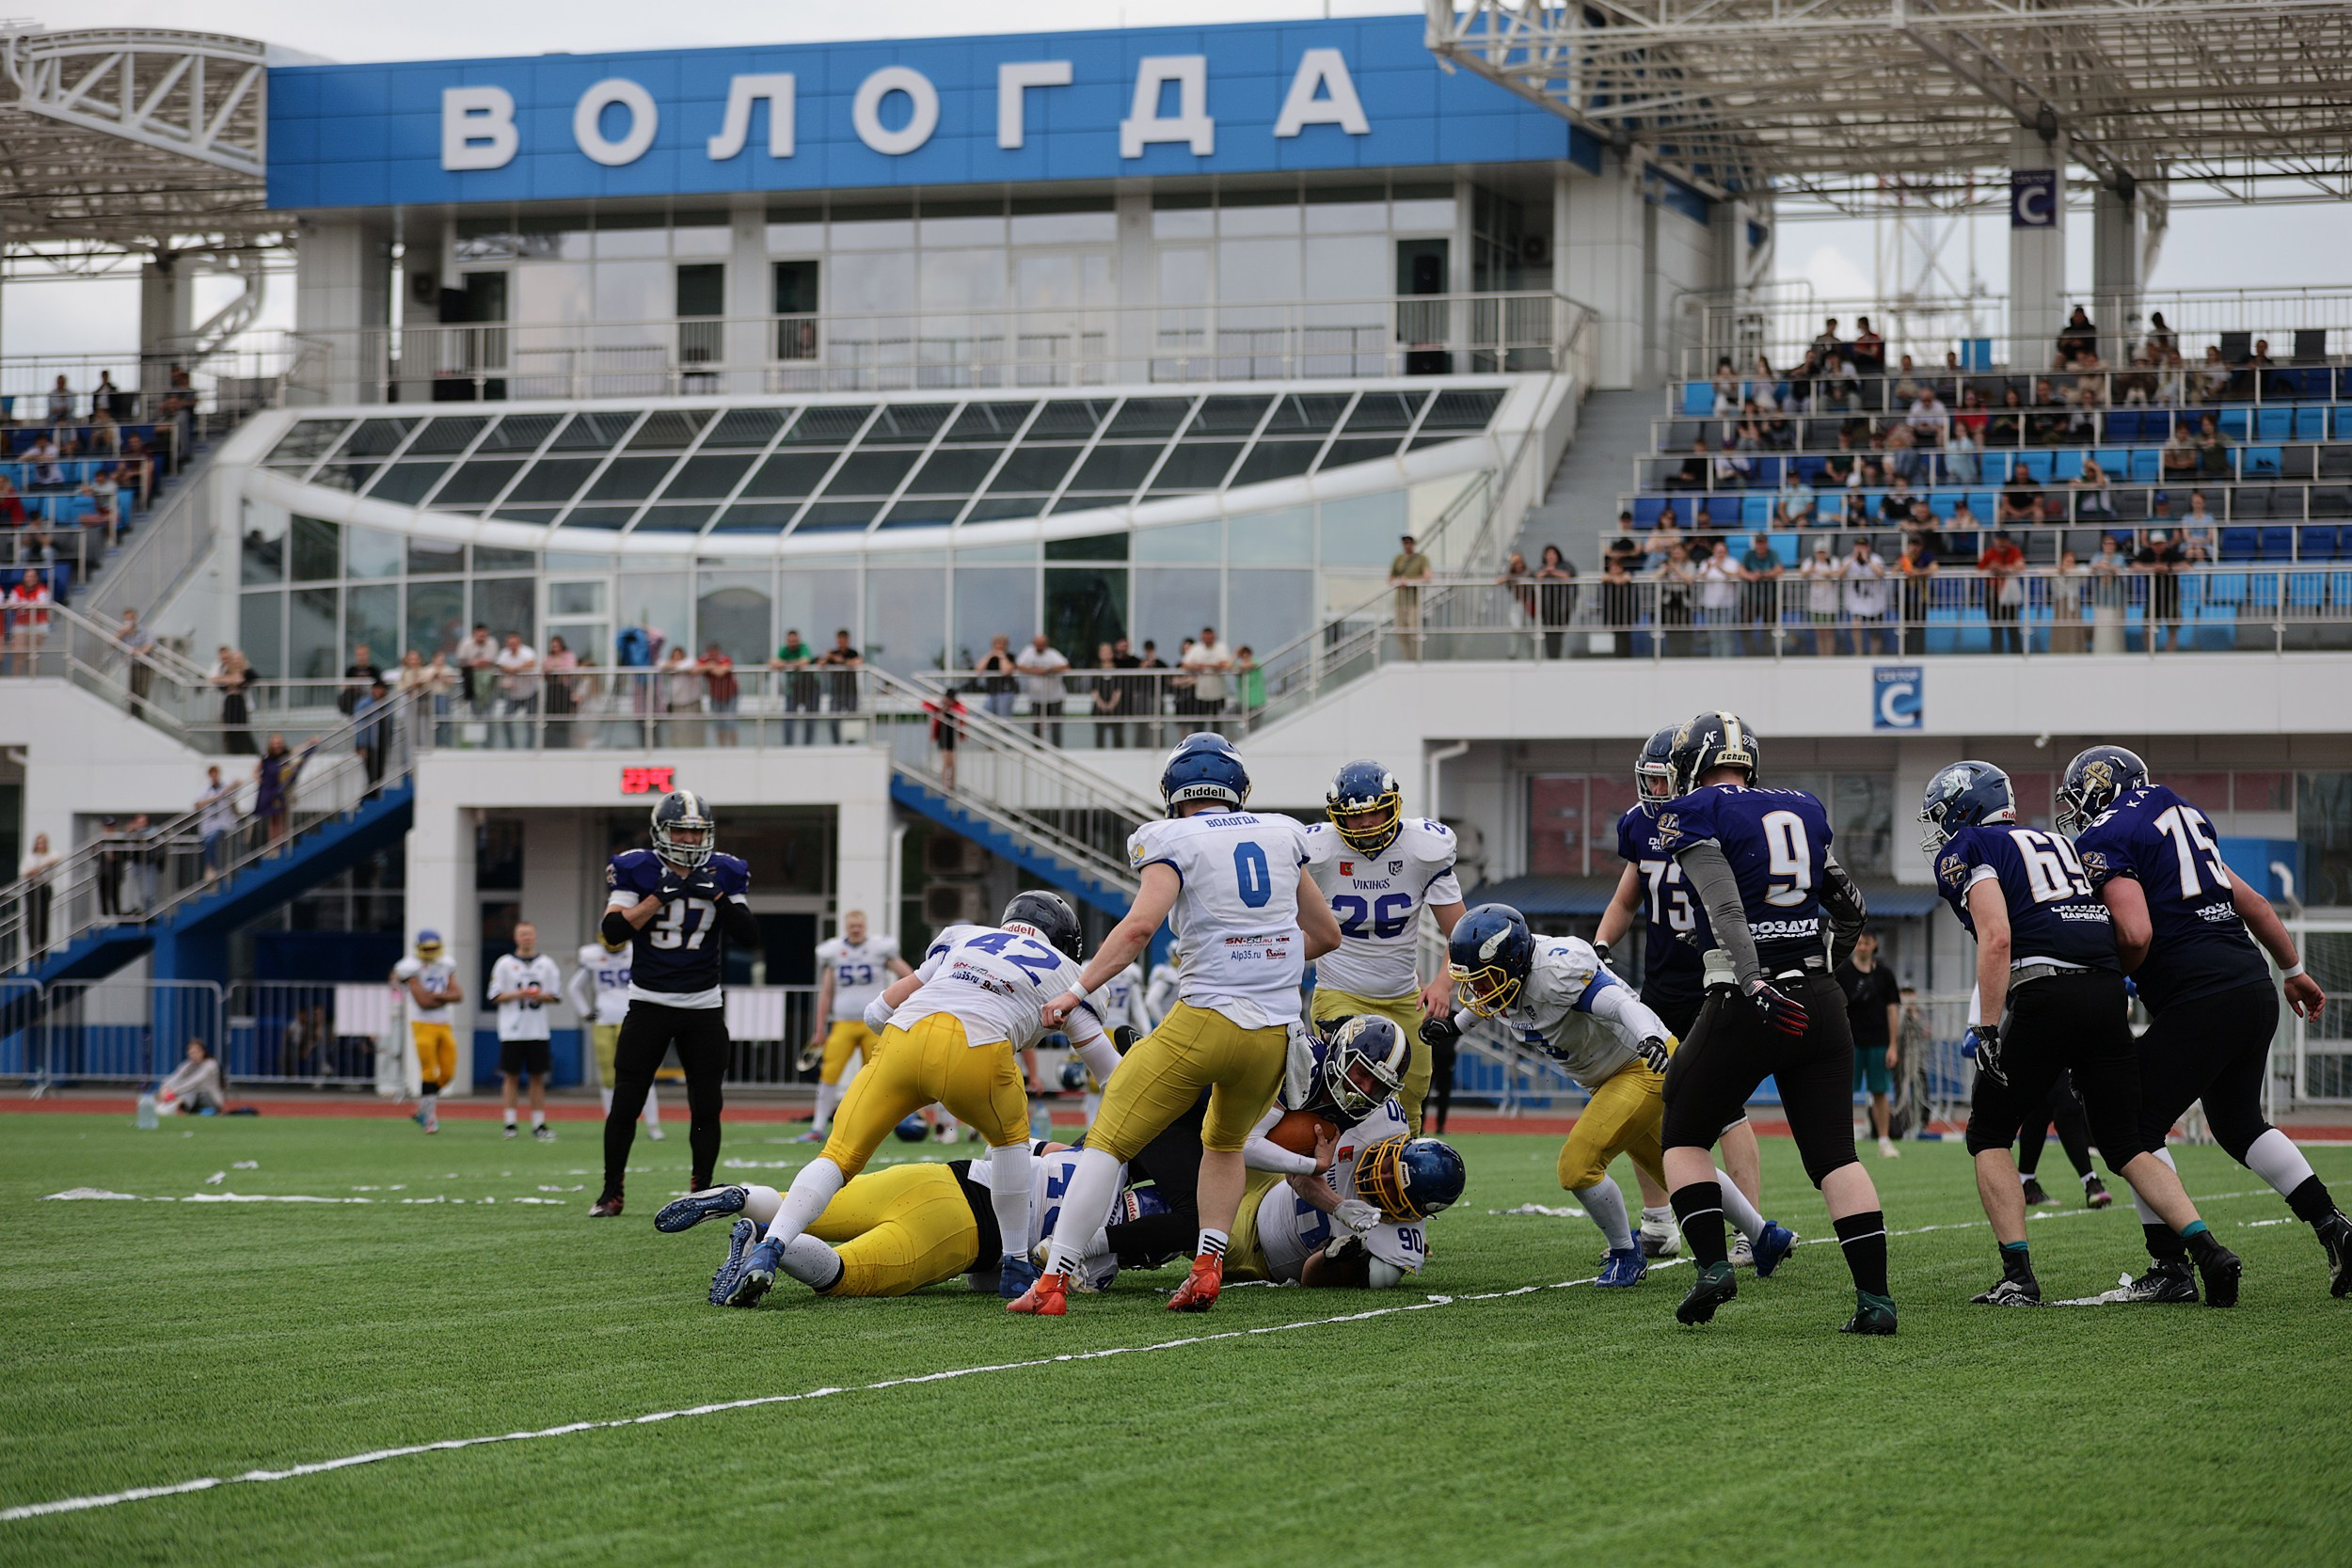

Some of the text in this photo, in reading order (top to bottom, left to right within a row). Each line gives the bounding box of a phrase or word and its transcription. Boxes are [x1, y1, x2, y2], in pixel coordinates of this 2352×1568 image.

[440, 48, 1370, 171] ВОЛОГДА
[2018, 186, 2048, 224] С
[1881, 683, 1915, 726] С
[1184, 786, 1226, 799] Riddell
[1205, 816, 1261, 828] ВОЛОГДА
[1232, 841, 1272, 909] 0
[1761, 810, 1812, 907] 9
[2008, 829, 2093, 904] 69
[2153, 805, 2233, 900] 75
[1353, 879, 1391, 890] VIKINGS
[650, 896, 717, 950] 37
[1331, 893, 1412, 940] 26
[839, 964, 873, 987] 53
[964, 932, 1062, 988] 42
[1231, 950, 1262, 961] Alp35.ru
[1397, 1227, 1422, 1254] 90
